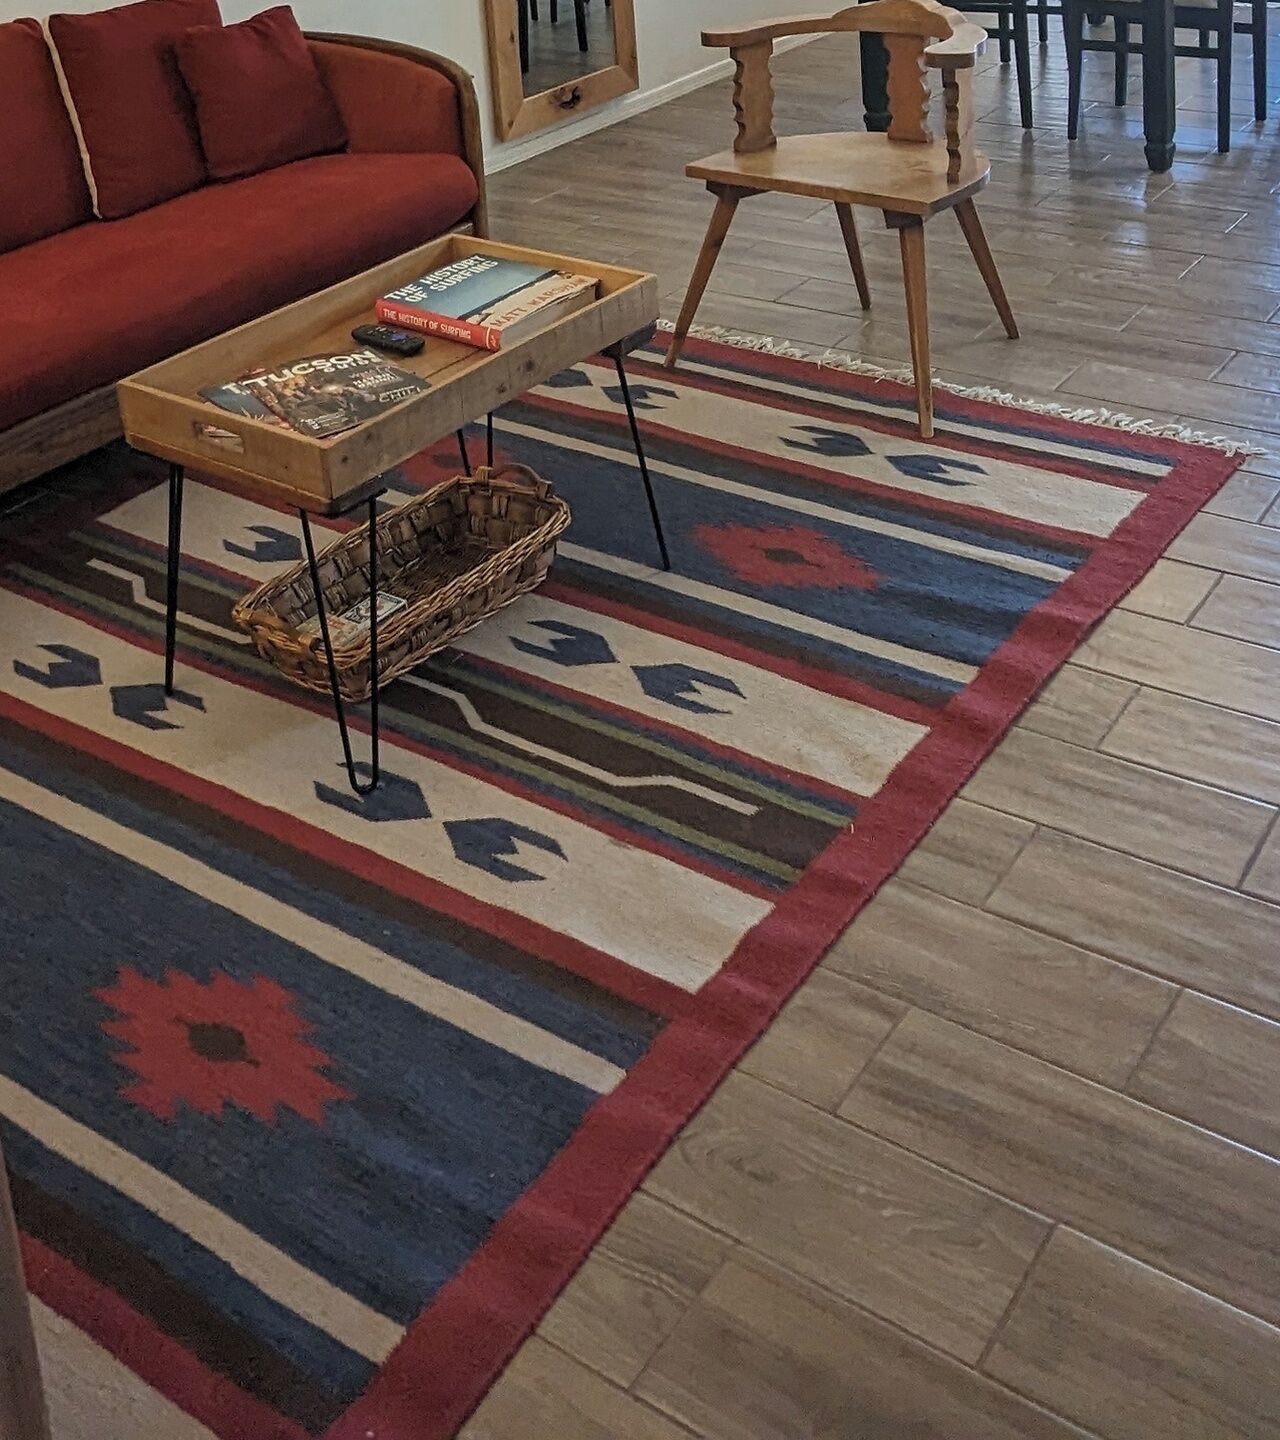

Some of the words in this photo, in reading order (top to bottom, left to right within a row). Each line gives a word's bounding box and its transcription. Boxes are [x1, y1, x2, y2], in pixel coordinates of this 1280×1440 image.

[384, 283, 422, 300] THE
[420, 255, 485, 285] HISTORY
[405, 290, 428, 302] OF
[430, 260, 498, 291] SURFING
[383, 308, 397, 321] THE
[398, 313, 428, 328] HISTORY
[429, 321, 439, 330] OF
[440, 323, 471, 339] SURFING
[242, 350, 383, 387] TUCSON
